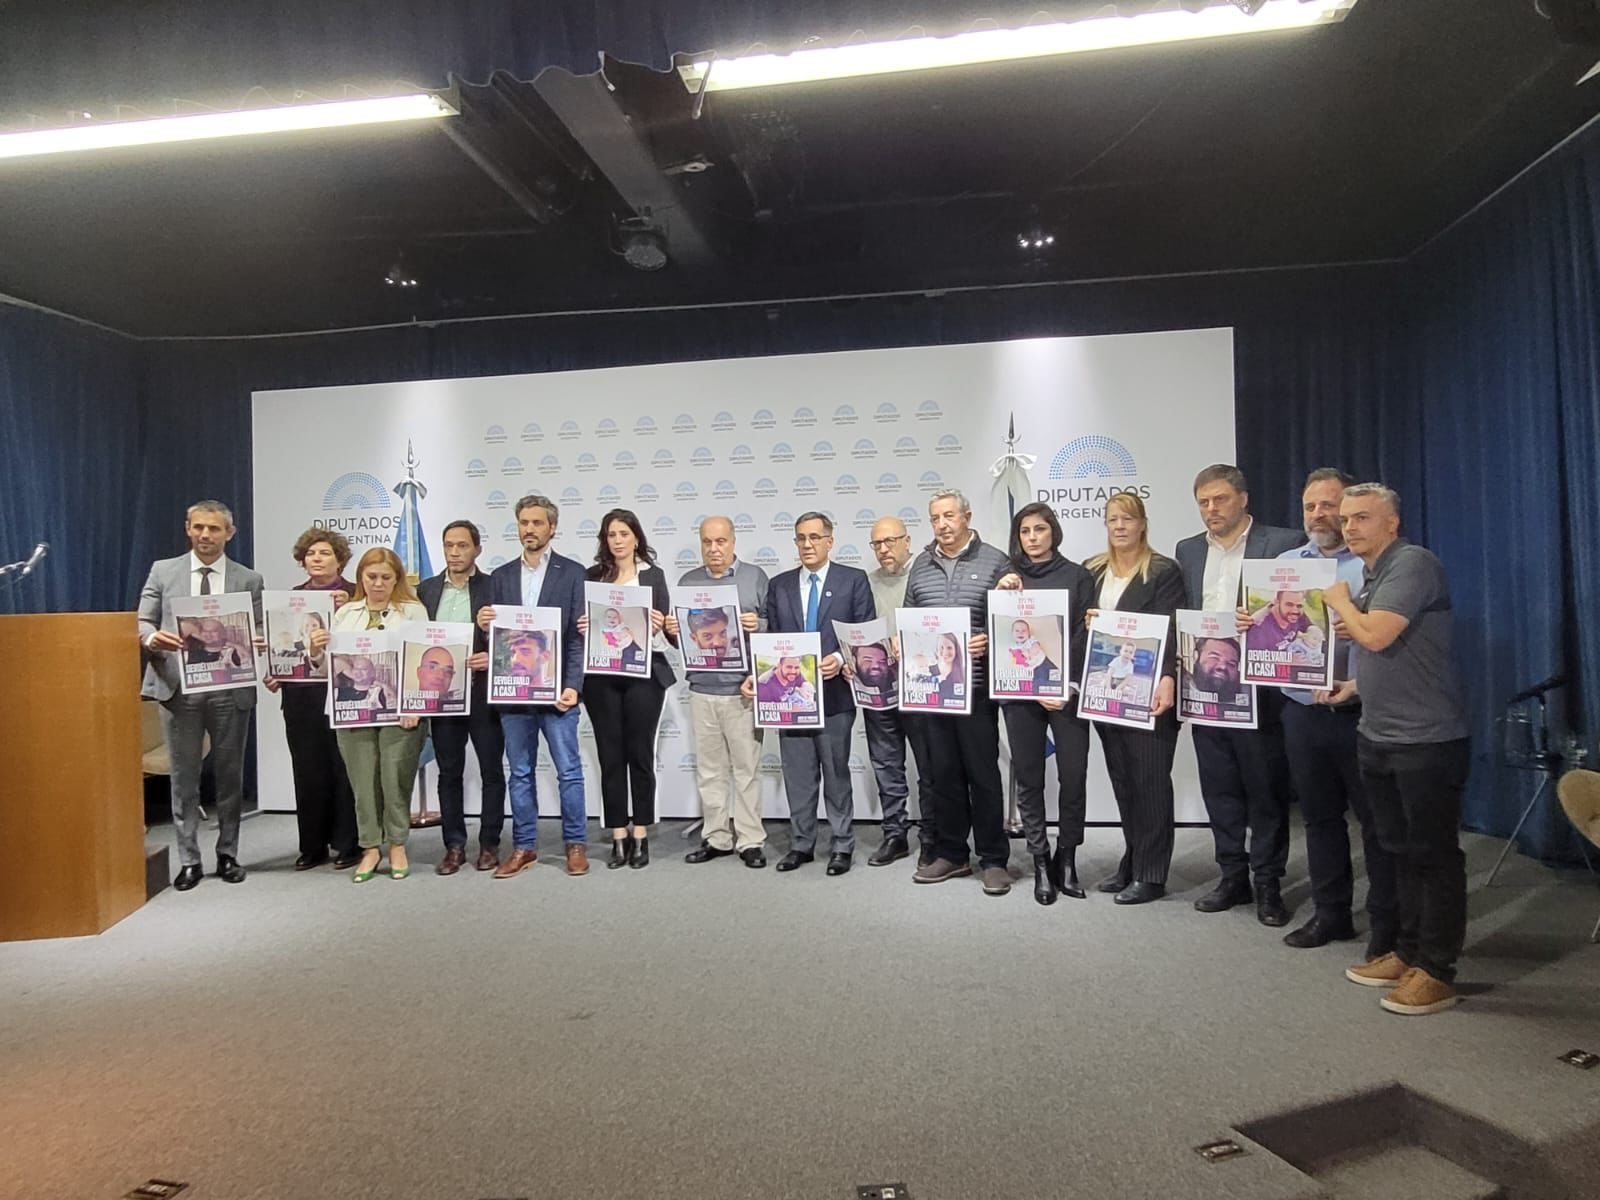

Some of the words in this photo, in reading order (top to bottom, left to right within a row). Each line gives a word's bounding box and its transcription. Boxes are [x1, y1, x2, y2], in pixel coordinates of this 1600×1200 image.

[1037, 485, 1150, 502] DIPUTADOS
[313, 516, 400, 531] DIPUTADOS
[348, 534, 392, 545] ENTINA
[1255, 663, 1275, 677] CASA
[499, 686, 516, 696] CASA
[1002, 680, 1019, 691] CASA
[910, 692, 927, 704] CASA
[1189, 701, 1204, 715] CASA
